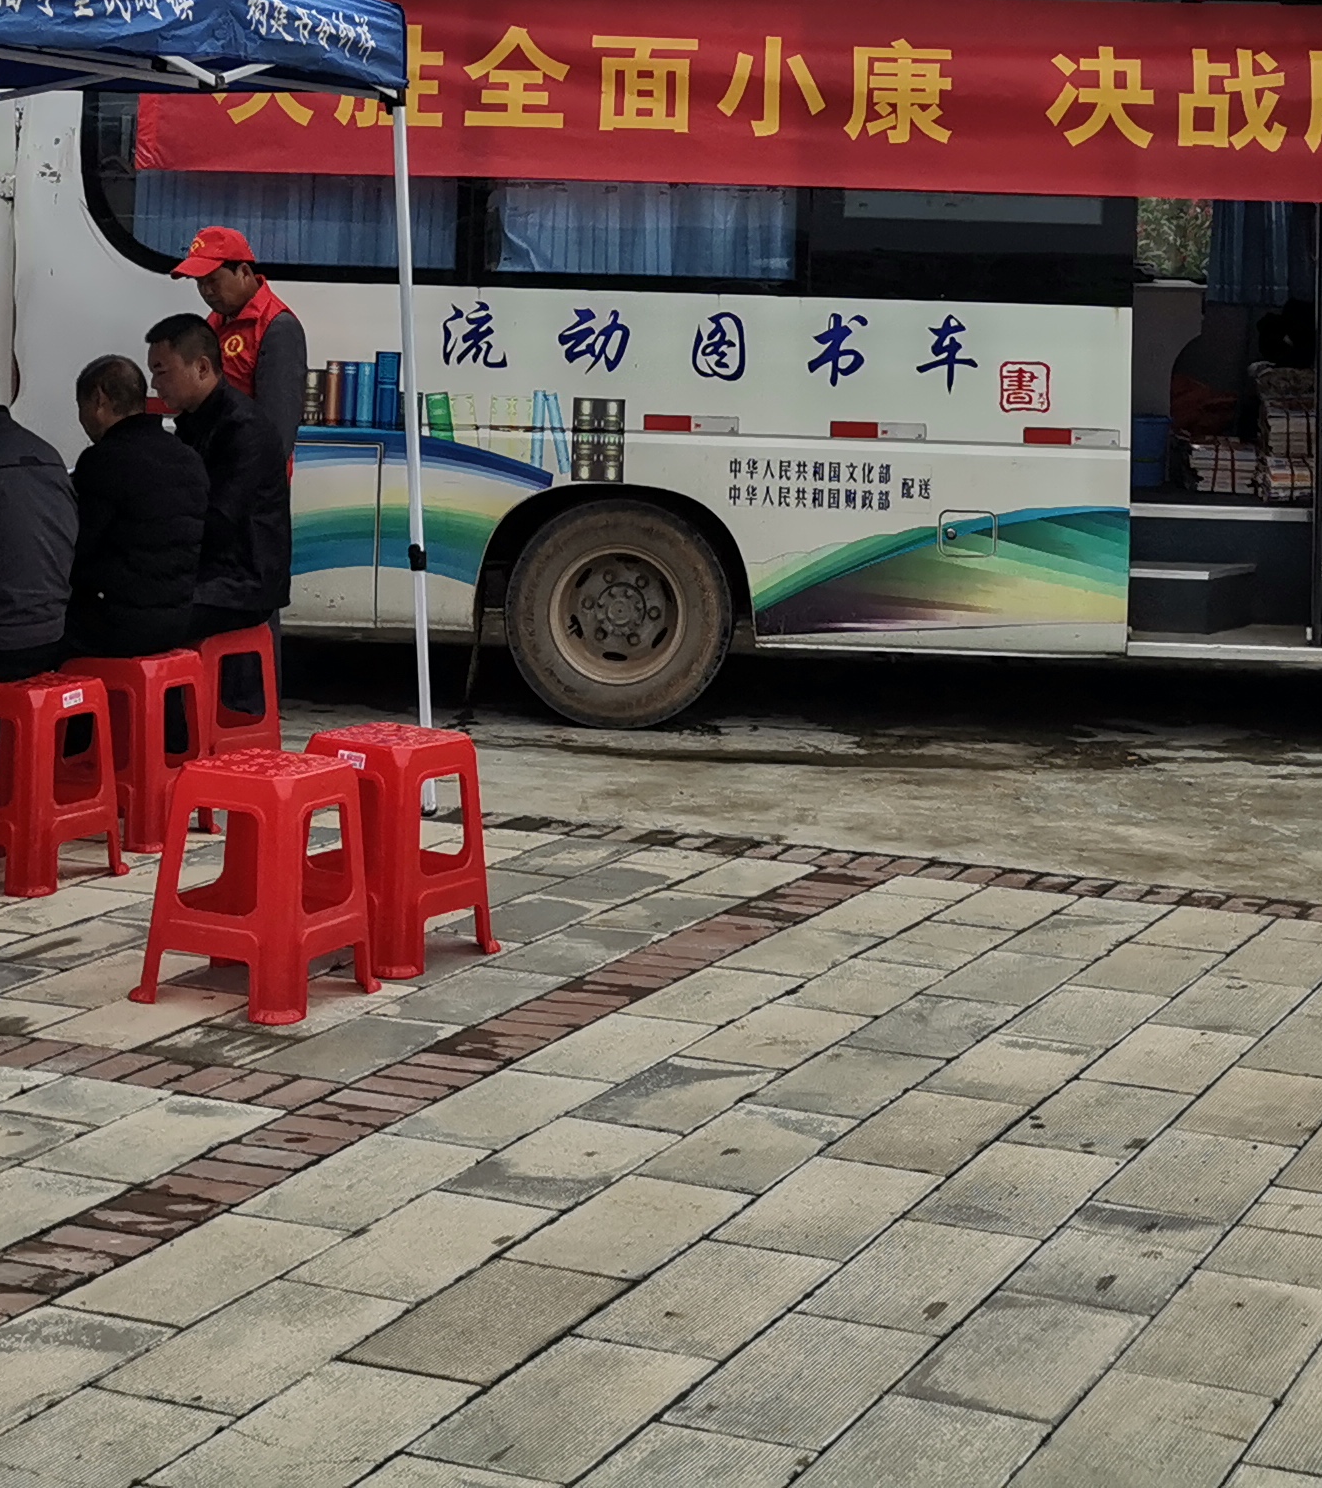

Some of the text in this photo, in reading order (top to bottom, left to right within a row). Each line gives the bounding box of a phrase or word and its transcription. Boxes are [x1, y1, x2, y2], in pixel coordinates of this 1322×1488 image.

[441, 301, 979, 394] 流动图书车
[729, 458, 892, 484] 中华人民共和国文化部
[728, 484, 891, 510] 中华人民共和国财政部
[901, 477, 931, 500] 配送
